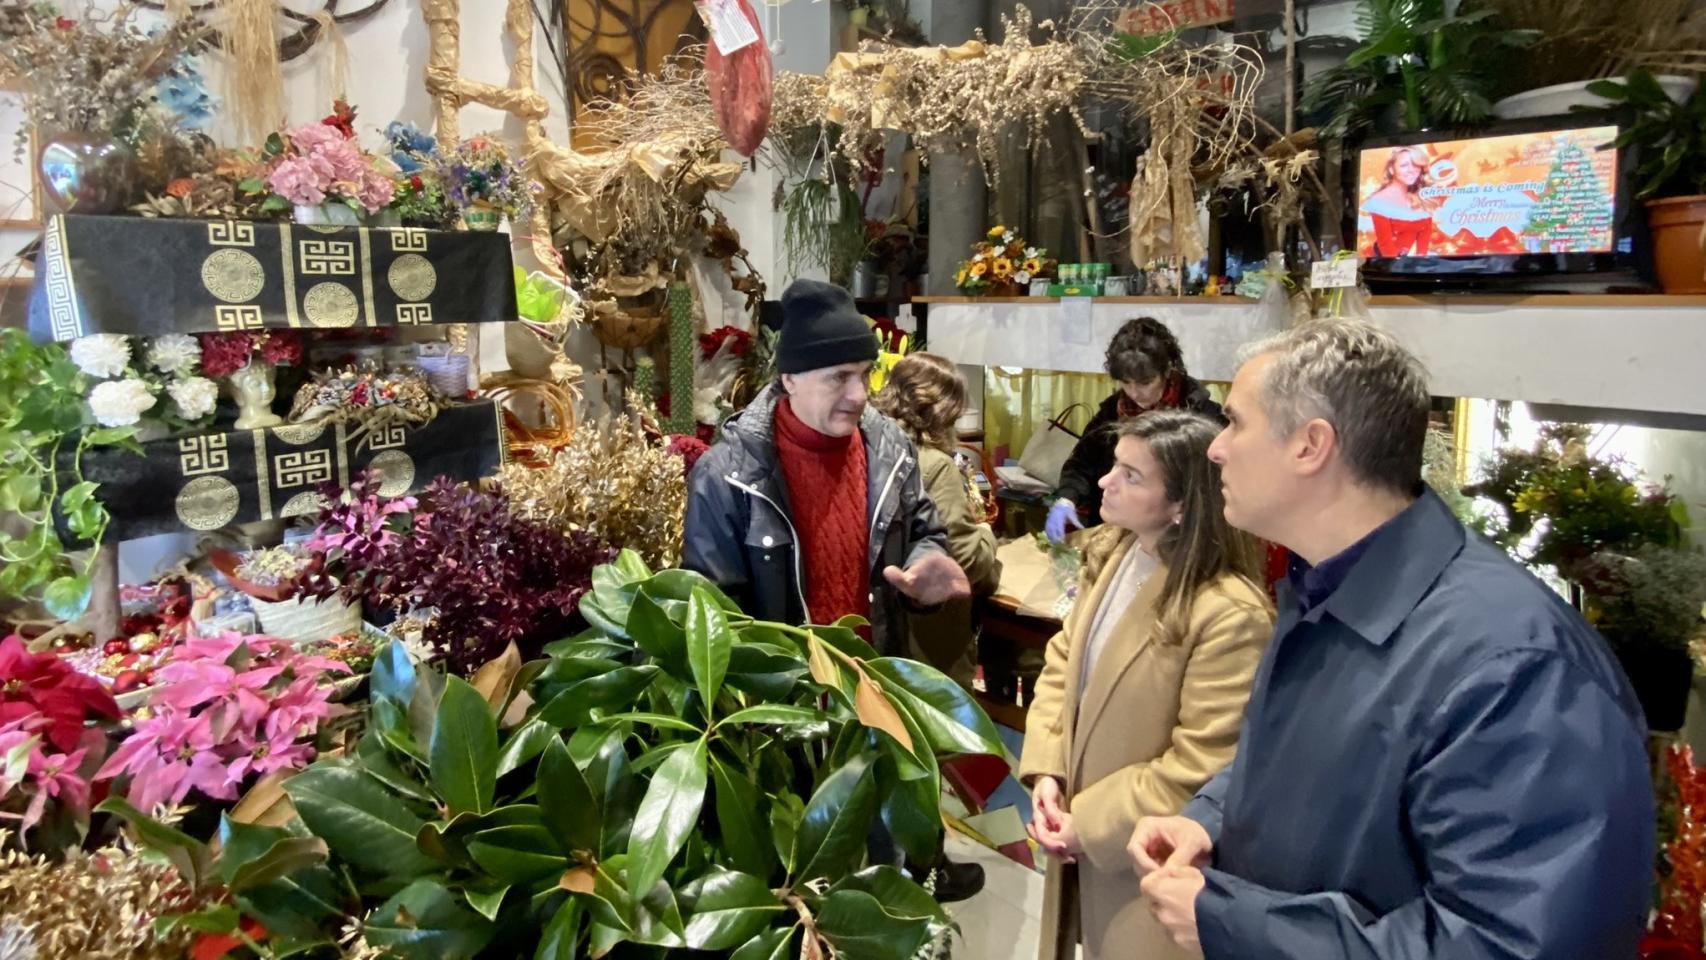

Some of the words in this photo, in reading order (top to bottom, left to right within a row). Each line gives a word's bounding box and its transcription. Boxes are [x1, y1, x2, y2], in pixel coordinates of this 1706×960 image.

[1421, 185, 1479, 197] Christmas
[1483, 184, 1493, 193] is
[1471, 197, 1506, 209] Merry
[1449, 208, 1521, 225] Christmas
